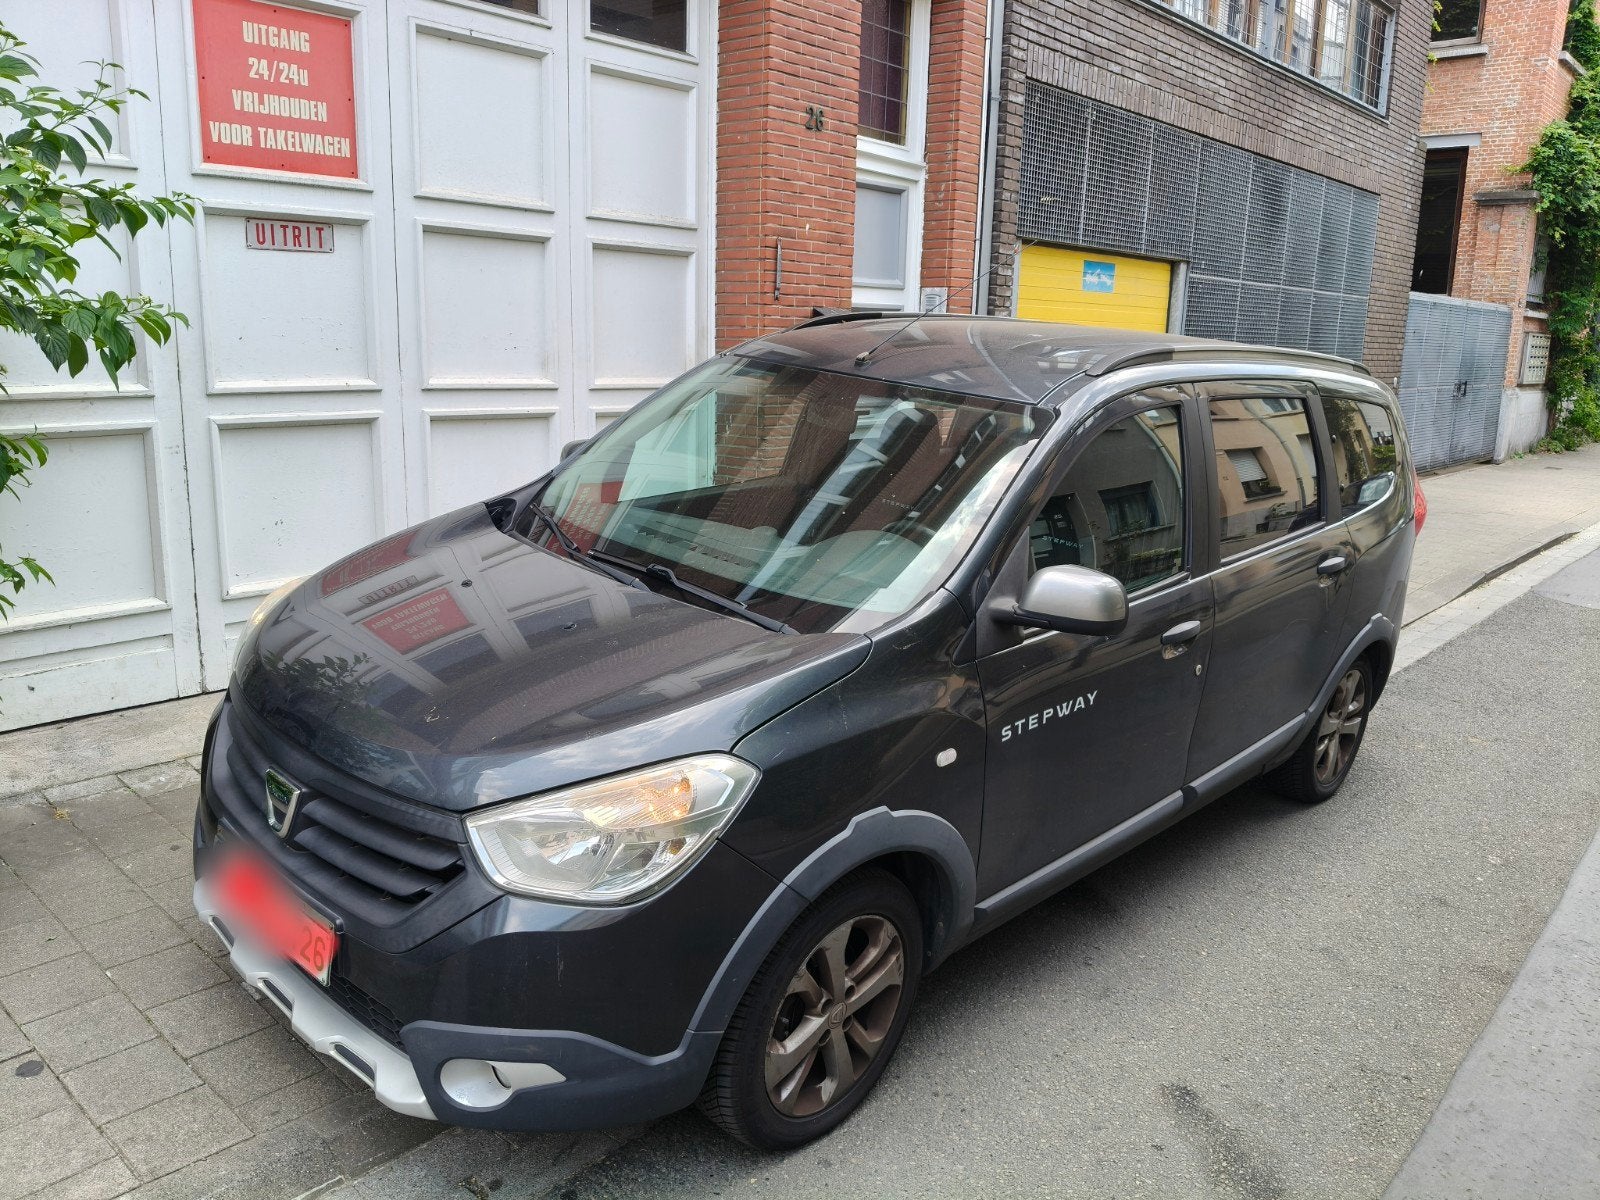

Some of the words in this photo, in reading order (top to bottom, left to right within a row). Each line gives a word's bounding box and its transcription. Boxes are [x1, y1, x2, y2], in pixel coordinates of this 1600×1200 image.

[242, 20, 310, 53] UITGANG
[248, 57, 309, 87] 24/24u
[231, 89, 327, 123] VRIJHOUDEN
[209, 120, 253, 147] VOOR
[257, 127, 351, 158] TAKELWAGEN
[255, 222, 325, 249] UITRIT
[1001, 689, 1098, 742] STEPWAY
